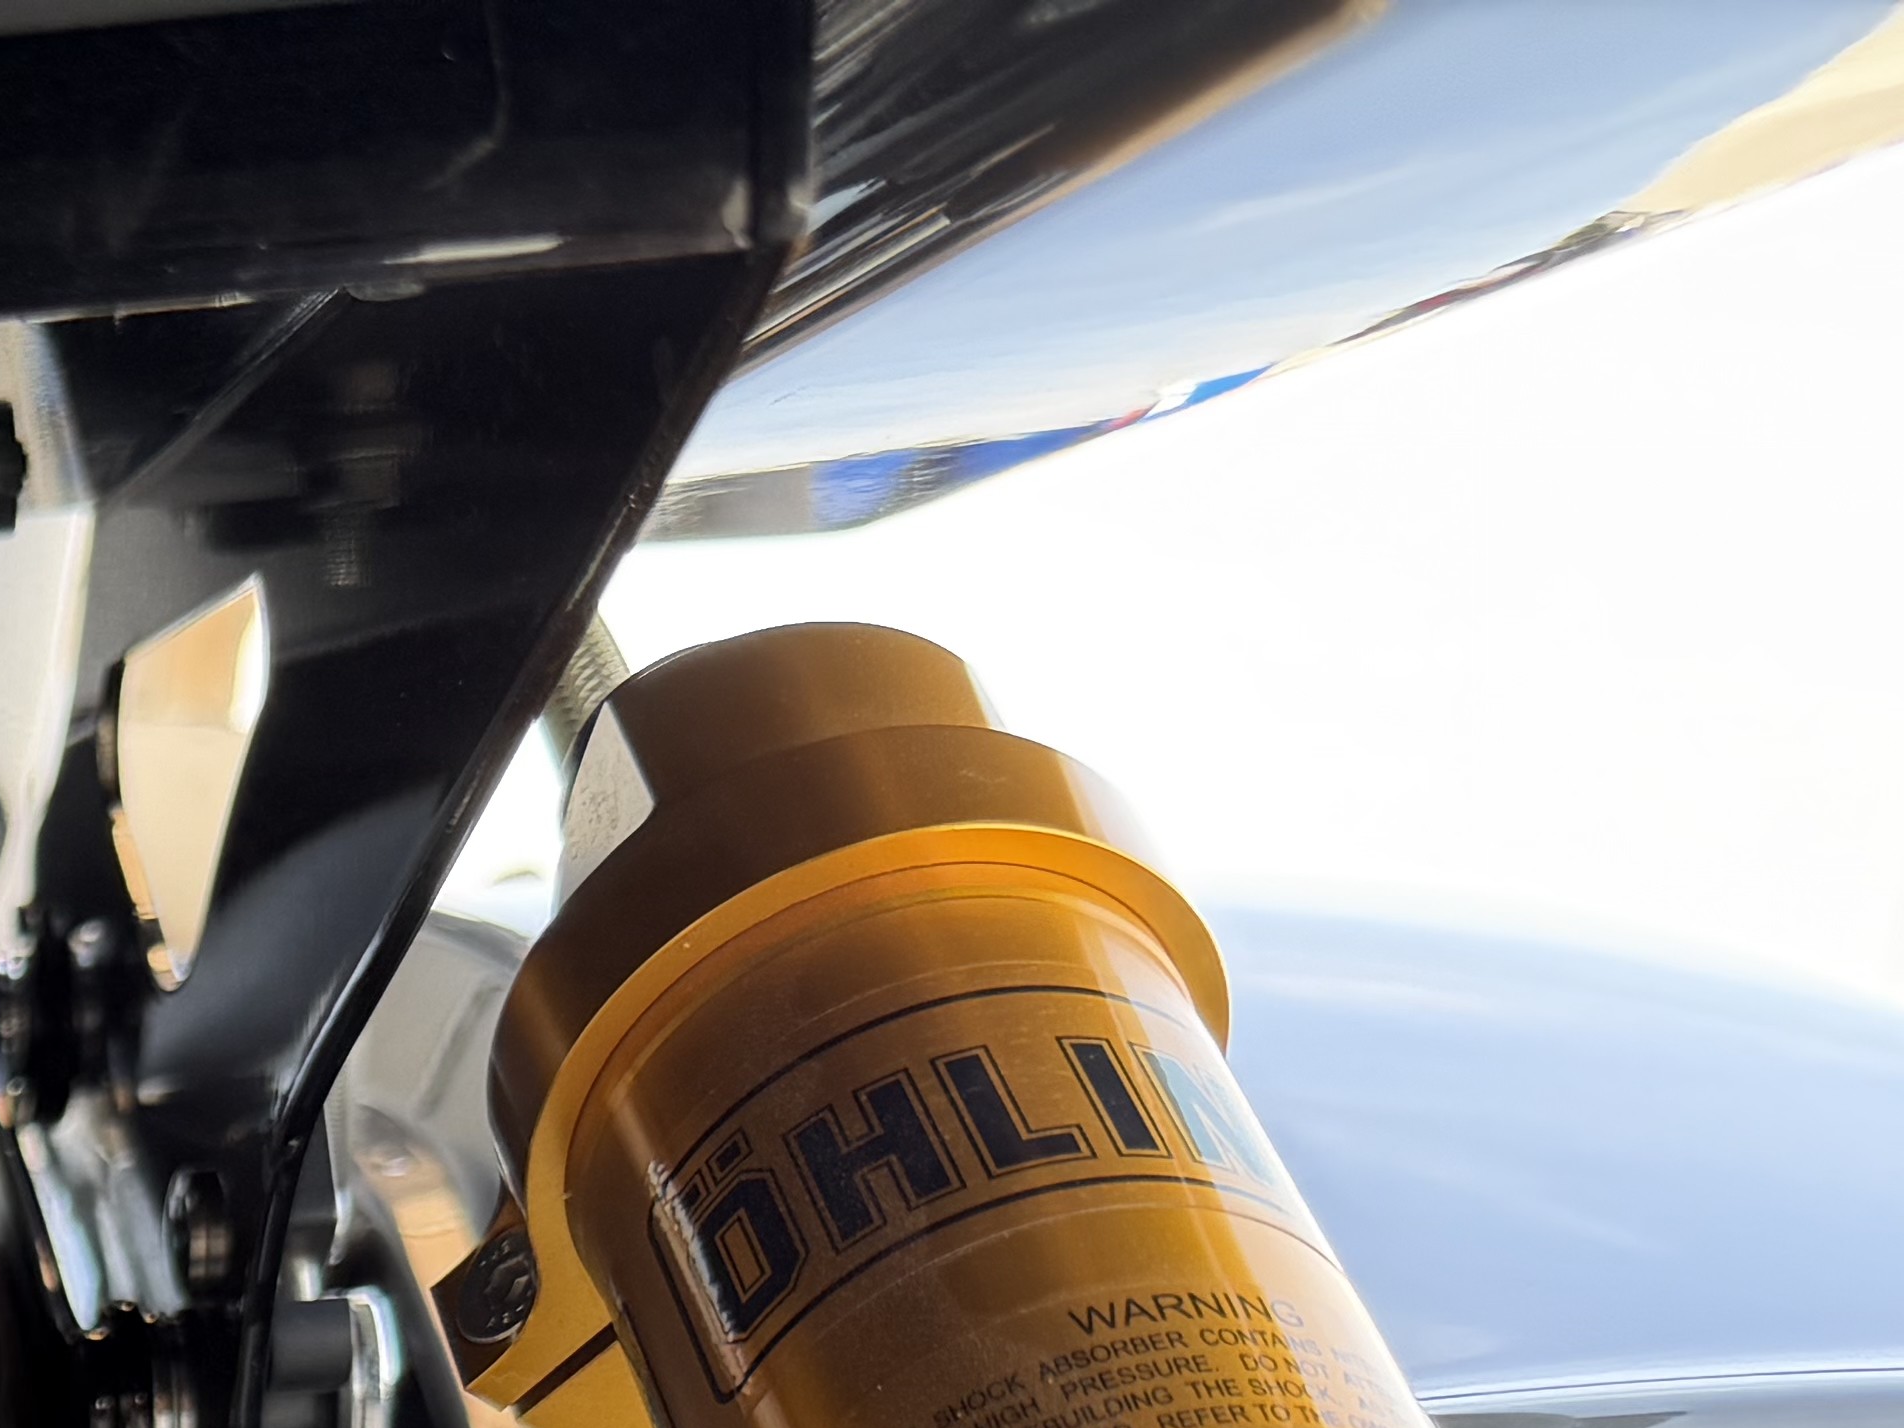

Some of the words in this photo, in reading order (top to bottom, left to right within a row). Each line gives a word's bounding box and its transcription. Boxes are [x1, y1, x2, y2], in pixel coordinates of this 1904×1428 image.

[1067, 1291, 1304, 1337] WARNING
[1039, 1330, 1189, 1380] ABSORBER
[1199, 1326, 1323, 1356] CONTAINS
[1059, 1353, 1220, 1402] PRESSURE.
[1239, 1352, 1278, 1373] DO
[1284, 1356, 1329, 1381] NOT
[1184, 1377, 1243, 1401] THE
[1252, 1403, 1290, 1422] TO
[1294, 1406, 1343, 1428] THE
